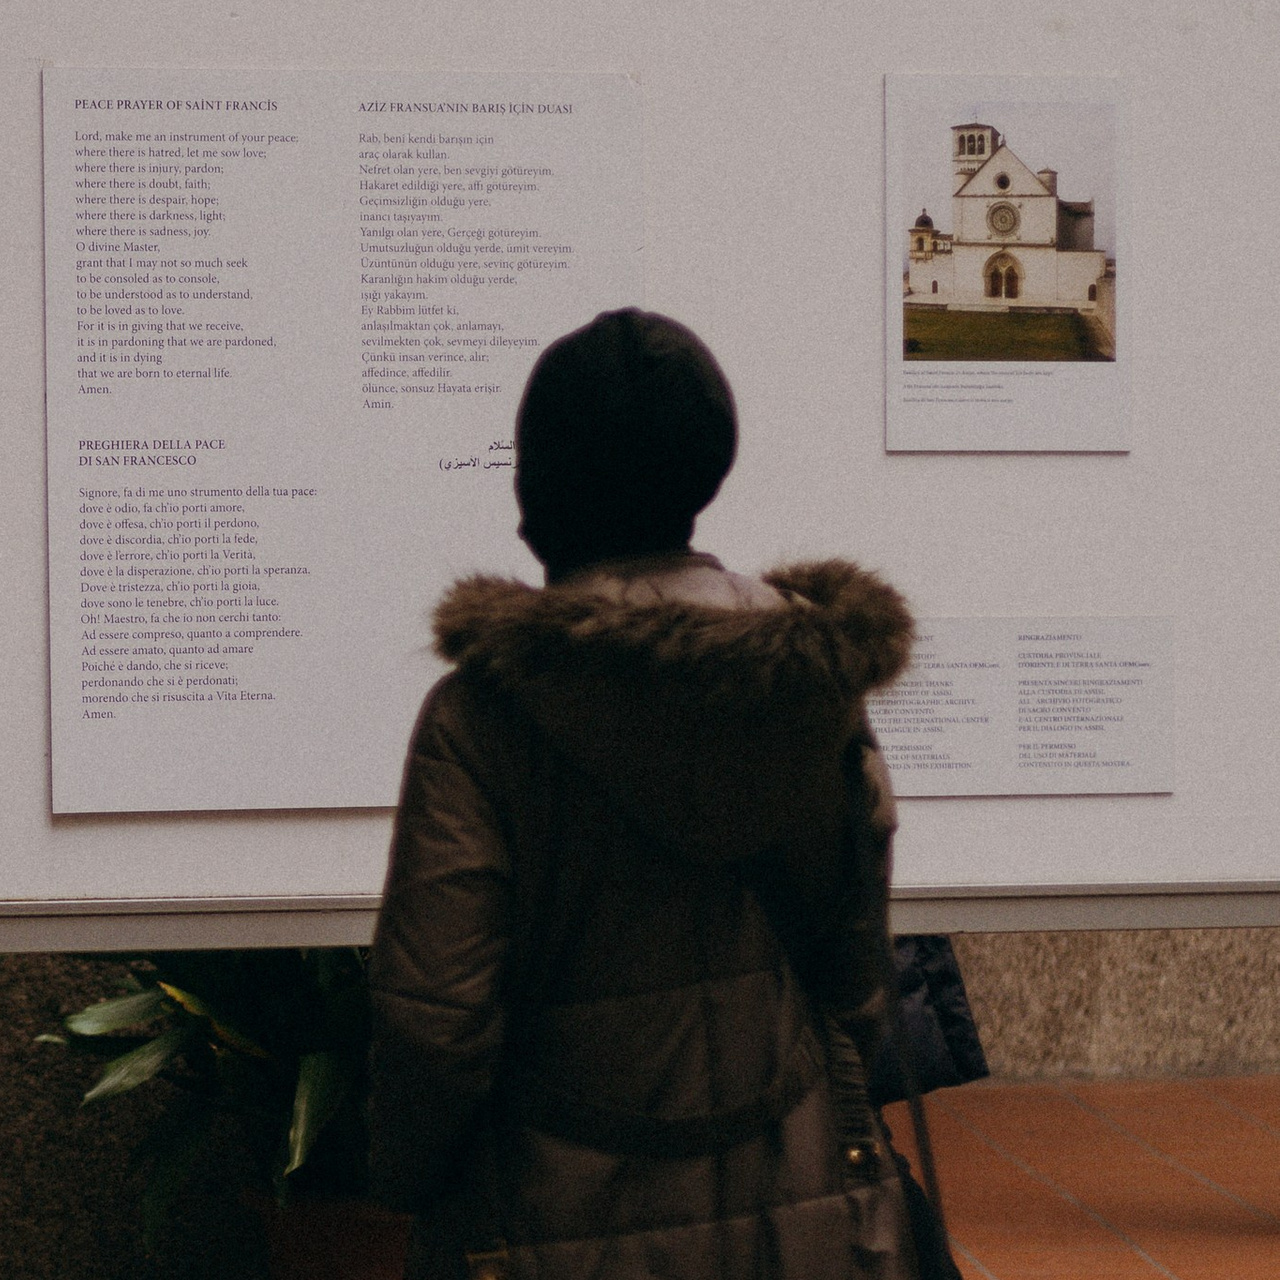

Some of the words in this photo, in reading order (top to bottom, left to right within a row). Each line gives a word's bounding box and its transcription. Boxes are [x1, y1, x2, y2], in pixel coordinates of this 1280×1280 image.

[74, 99, 114, 110] PEACE
[116, 99, 164, 110] PRAYER
[166, 100, 183, 110] OF
[185, 98, 222, 110] SAİNT
[225, 98, 279, 110] FRANCİS
[74, 131, 103, 142] Lord,
[105, 131, 134, 141] make
[169, 131, 227, 142] instrument
[228, 132, 240, 142] of
[241, 134, 265, 145] your
[267, 134, 299, 145] peace:
[75, 147, 107, 157] where
[108, 147, 136, 157] there
[137, 147, 147, 157] is
[148, 147, 185, 159] hatred,
[186, 147, 200, 157] let
[242, 147, 267, 159] love;
[75, 178, 107, 188] where
[108, 178, 136, 188] there
[137, 178, 147, 188] is
[148, 178, 182, 190] doubt,
[184, 178, 211, 190] faith;
[75, 241, 87, 251] O
[88, 241, 121, 251] divine
[123, 241, 161, 253] Master,
[75, 259, 104, 270] grant
[105, 257, 127, 267] that
[128, 257, 134, 267] I
[136, 259, 158, 270] may
[160, 259, 178, 267] not
[194, 257, 224, 267] much
[226, 257, 249, 267] seek
[76, 320, 95, 331] For
[97, 320, 106, 330] it
[107, 320, 117, 330] is
[118, 320, 130, 330] in
[131, 320, 164, 333] giving
[165, 320, 187, 330] that
[205, 320, 244, 332] receive,
[78, 383, 113, 394] Amen.
[78, 439, 150, 450] PREGHIERA
[152, 439, 192, 449] DELLA
[195, 439, 226, 449] PACE
[78, 455, 93, 465] DI
[95, 455, 121, 465] SAN
[123, 455, 198, 465] FRANCESCO
[79, 487, 121, 500] Signore,
[123, 486, 134, 497] fa
[135, 486, 147, 497] di
[167, 488, 189, 496] uno
[190, 488, 244, 496] strumento
[245, 486, 271, 496] della
[272, 487, 290, 496] tua
[291, 488, 318, 499] pace:
[79, 518, 105, 529] dove
[106, 518, 113, 528] è
[114, 518, 148, 530] offesa,
[149, 518, 175, 528] ch'io
[176, 518, 203, 531] porti
[204, 518, 212, 528] il
[213, 517, 260, 531] perdono,
[80, 581, 108, 592] Dove
[109, 581, 117, 592] è
[118, 581, 164, 593] tristezza,
[166, 581, 191, 591] ch'io
[192, 580, 219, 594] porti
[220, 580, 231, 590] la
[232, 580, 261, 593] gioia,
[82, 692, 130, 702] morendo
[131, 691, 150, 702] che
[151, 691, 161, 701] si
[162, 691, 206, 701] risuscita
[216, 690, 238, 701] Vita
[240, 690, 276, 700] Eterna.
